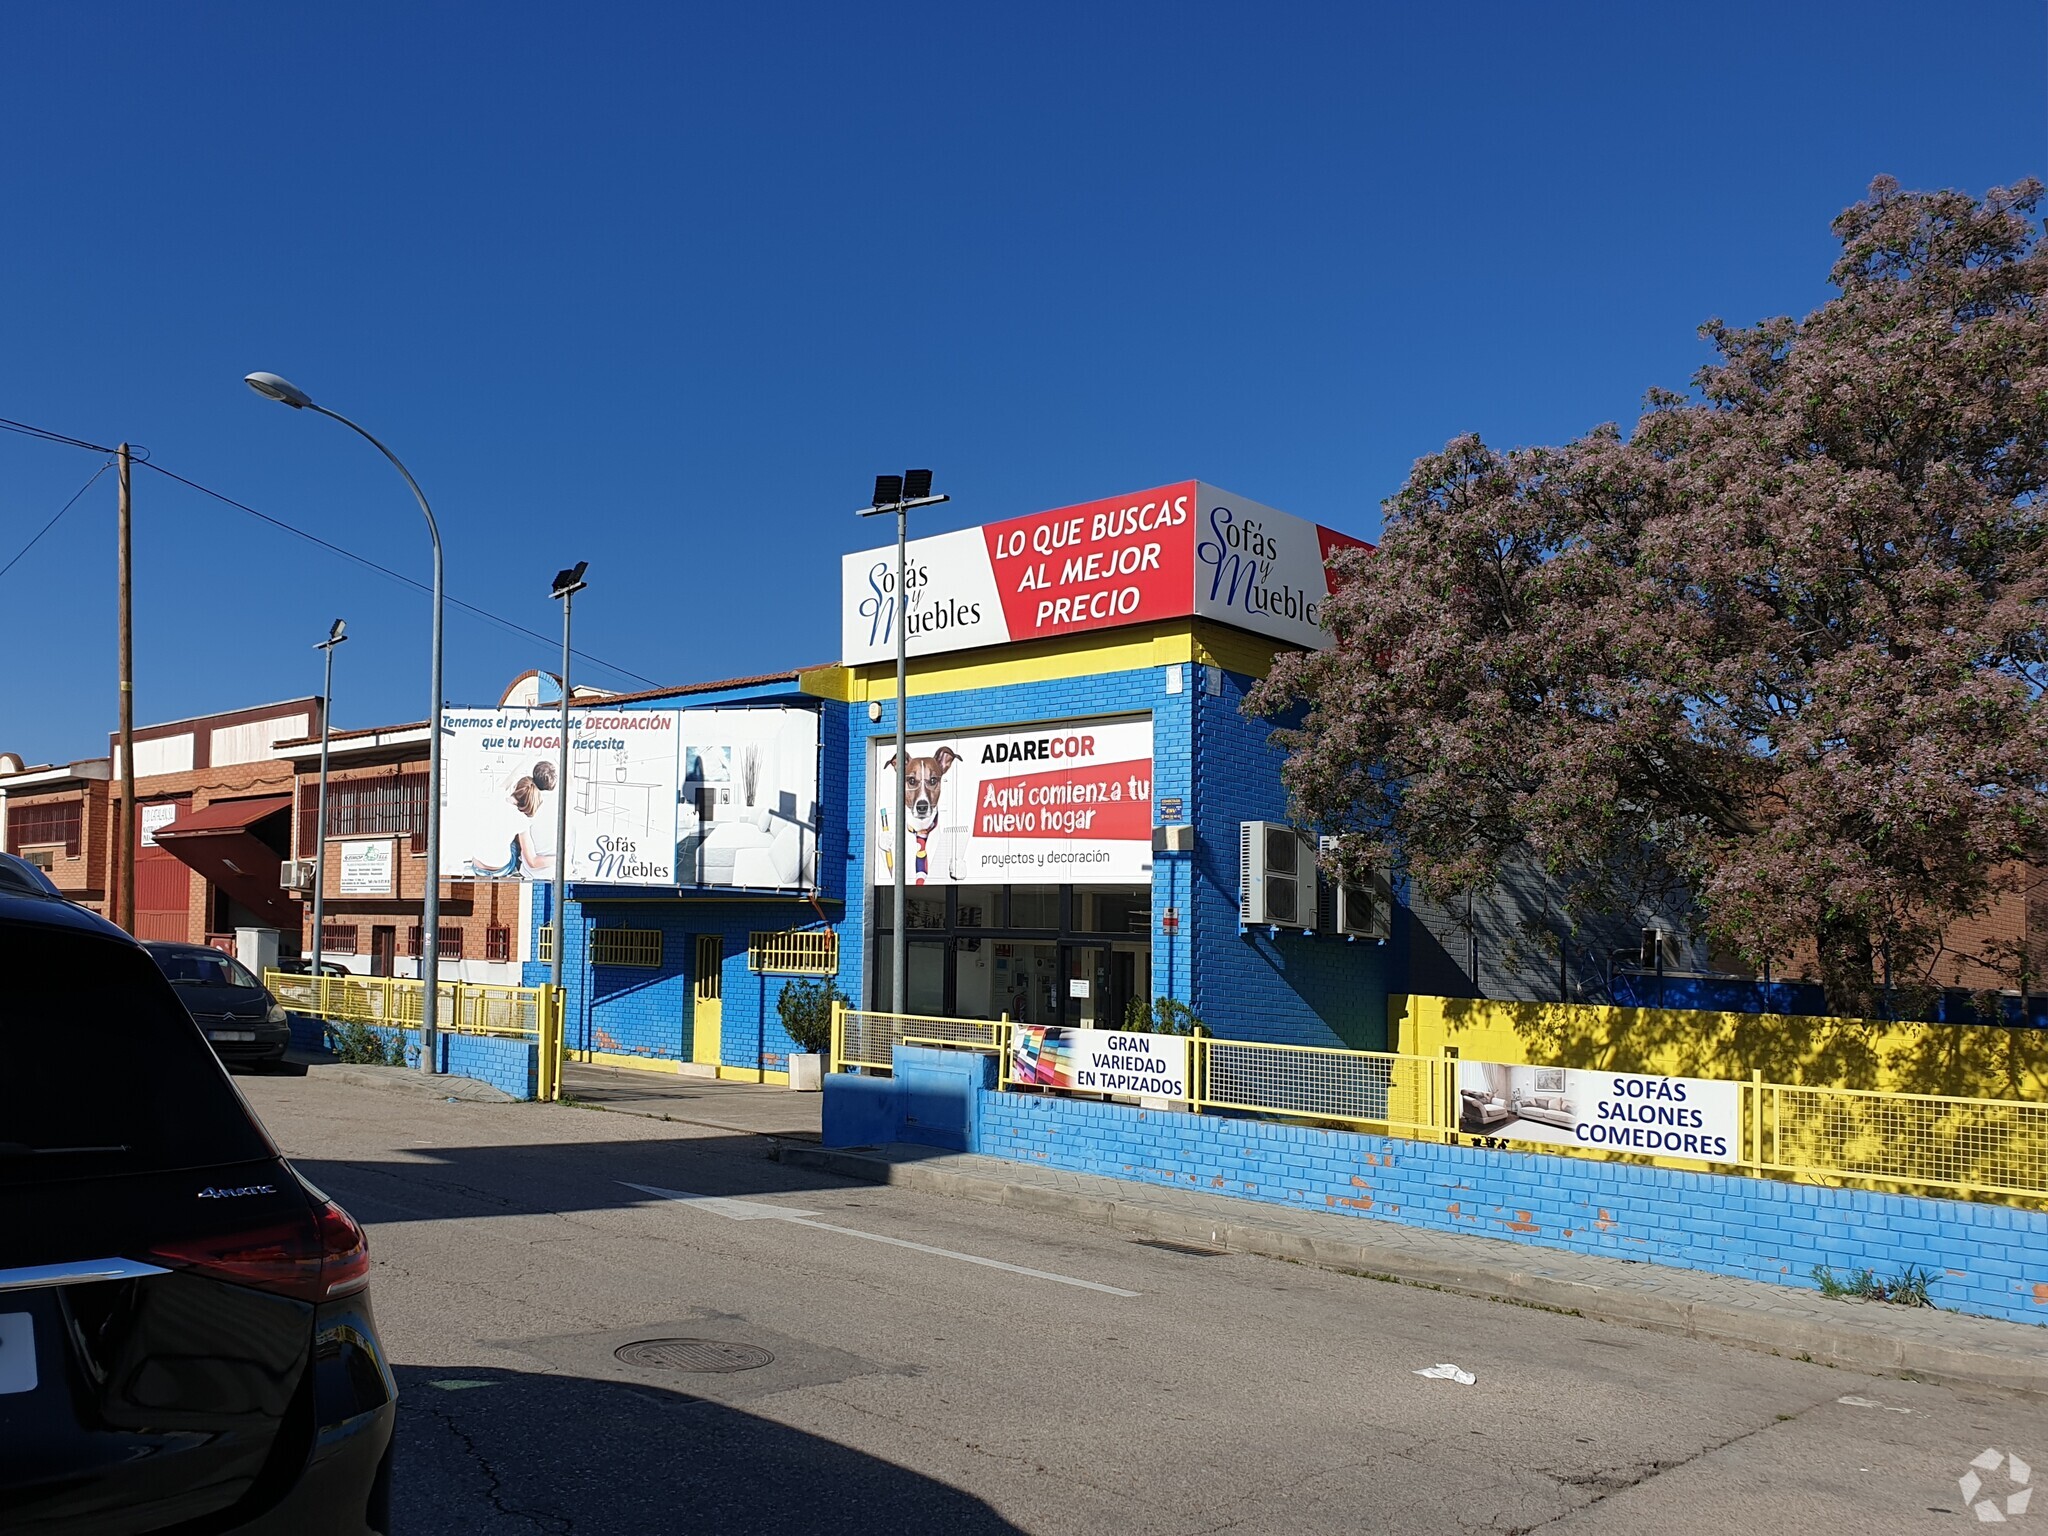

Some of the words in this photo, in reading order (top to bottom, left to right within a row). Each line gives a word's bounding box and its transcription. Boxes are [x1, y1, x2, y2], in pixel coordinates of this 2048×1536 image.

[995, 530, 1026, 560] LO
[1032, 517, 1085, 556] QUE
[1090, 496, 1188, 542] BUSCAS
[1210, 506, 1277, 561] Sofás
[1017, 563, 1052, 592] AL
[1059, 543, 1161, 586] MEJOR
[1259, 560, 1274, 584] y
[869, 558, 928, 606] Soás
[1197, 541, 1318, 626] Mueble
[911, 589, 925, 612] y
[1035, 586, 1141, 628] PRECIO
[859, 595, 981, 647] Muebles
[442, 715, 493, 728] Tenemos
[496, 715, 507, 728] el
[568, 717, 582, 729] de
[585, 715, 671, 730] DECORACIÓN
[482, 738, 504, 749] que
[507, 737, 520, 748] tu
[523, 736, 569, 749] HOGA
[572, 737, 625, 750] necesita
[981, 735, 1095, 764] ADARECOR
[983, 781, 1027, 812] Aquí
[1028, 781, 1122, 806] comienza
[1127, 775, 1150, 800] tu
[982, 811, 1036, 834] nuevo
[1040, 807, 1097, 834] hogar
[596, 835, 636, 858] Sofás
[981, 853, 1035, 868] proyectos
[1037, 855, 1045, 867] y
[1047, 849, 1110, 865] decoración
[588, 852, 669, 879] Muebles
[1107, 1036, 1150, 1053] GRAN
[1092, 1053, 1167, 1074] VARIEDAD
[1078, 1070, 1096, 1086] EN
[1100, 1072, 1182, 1096] TAPIZADOS
[1613, 1077, 1687, 1102] SOFÁS
[1597, 1101, 1703, 1128] SALONES
[1575, 1123, 1727, 1156] COMEDORES
[197, 1184, 277, 1199] 4MATIC
